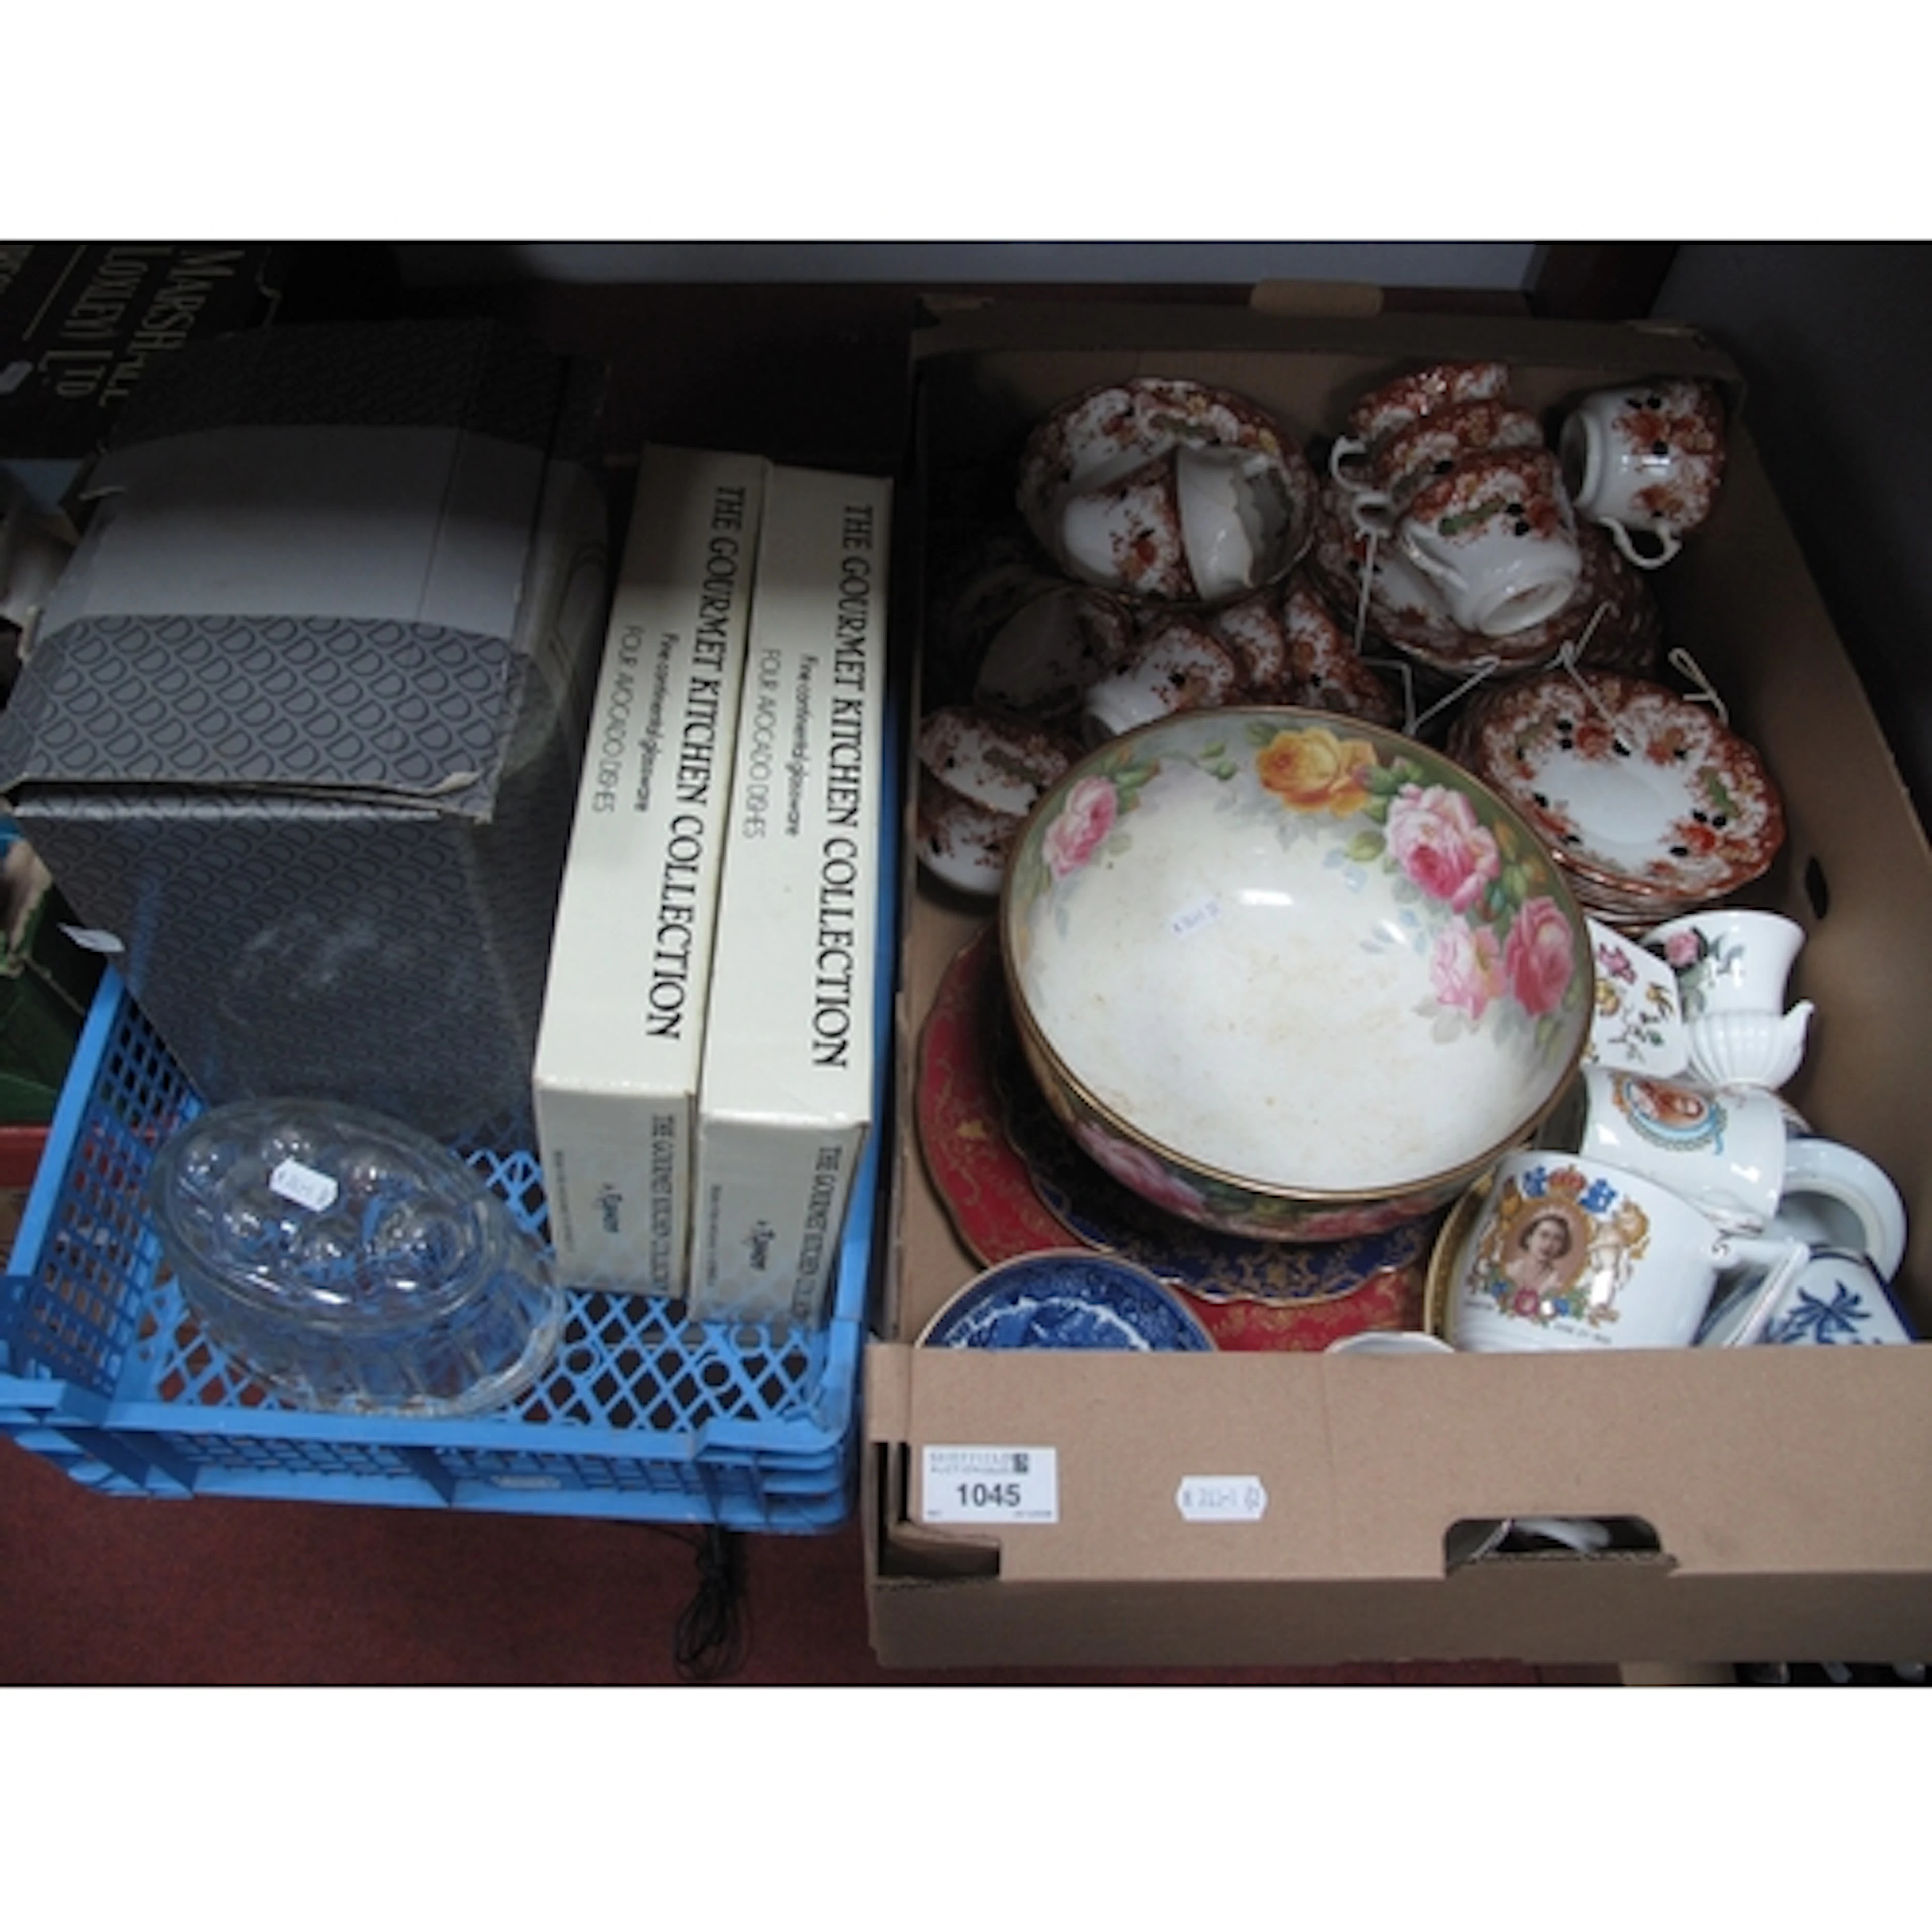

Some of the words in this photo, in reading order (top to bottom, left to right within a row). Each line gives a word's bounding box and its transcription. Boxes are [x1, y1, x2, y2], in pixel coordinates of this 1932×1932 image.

[711, 486, 745, 532] THE
[843, 506, 873, 550] THE
[618, 625, 646, 667] FOUR
[692, 537, 738, 672] GOURMET
[834, 557, 870, 693] GOURMET
[759, 648, 782, 690] FOUR
[603, 672, 635, 757] AVOCADO
[676, 677, 723, 808] KITCHEN
[750, 695, 777, 780] AVOCADO
[592, 758, 623, 813] DISHES
[827, 698, 865, 829] KITCHEN
[742, 783, 769, 839] DISHES
[646, 815, 703, 1039] COLLECTION
[813, 839, 858, 1068] COLLECTION
[957, 1482, 1022, 1508] 1045
